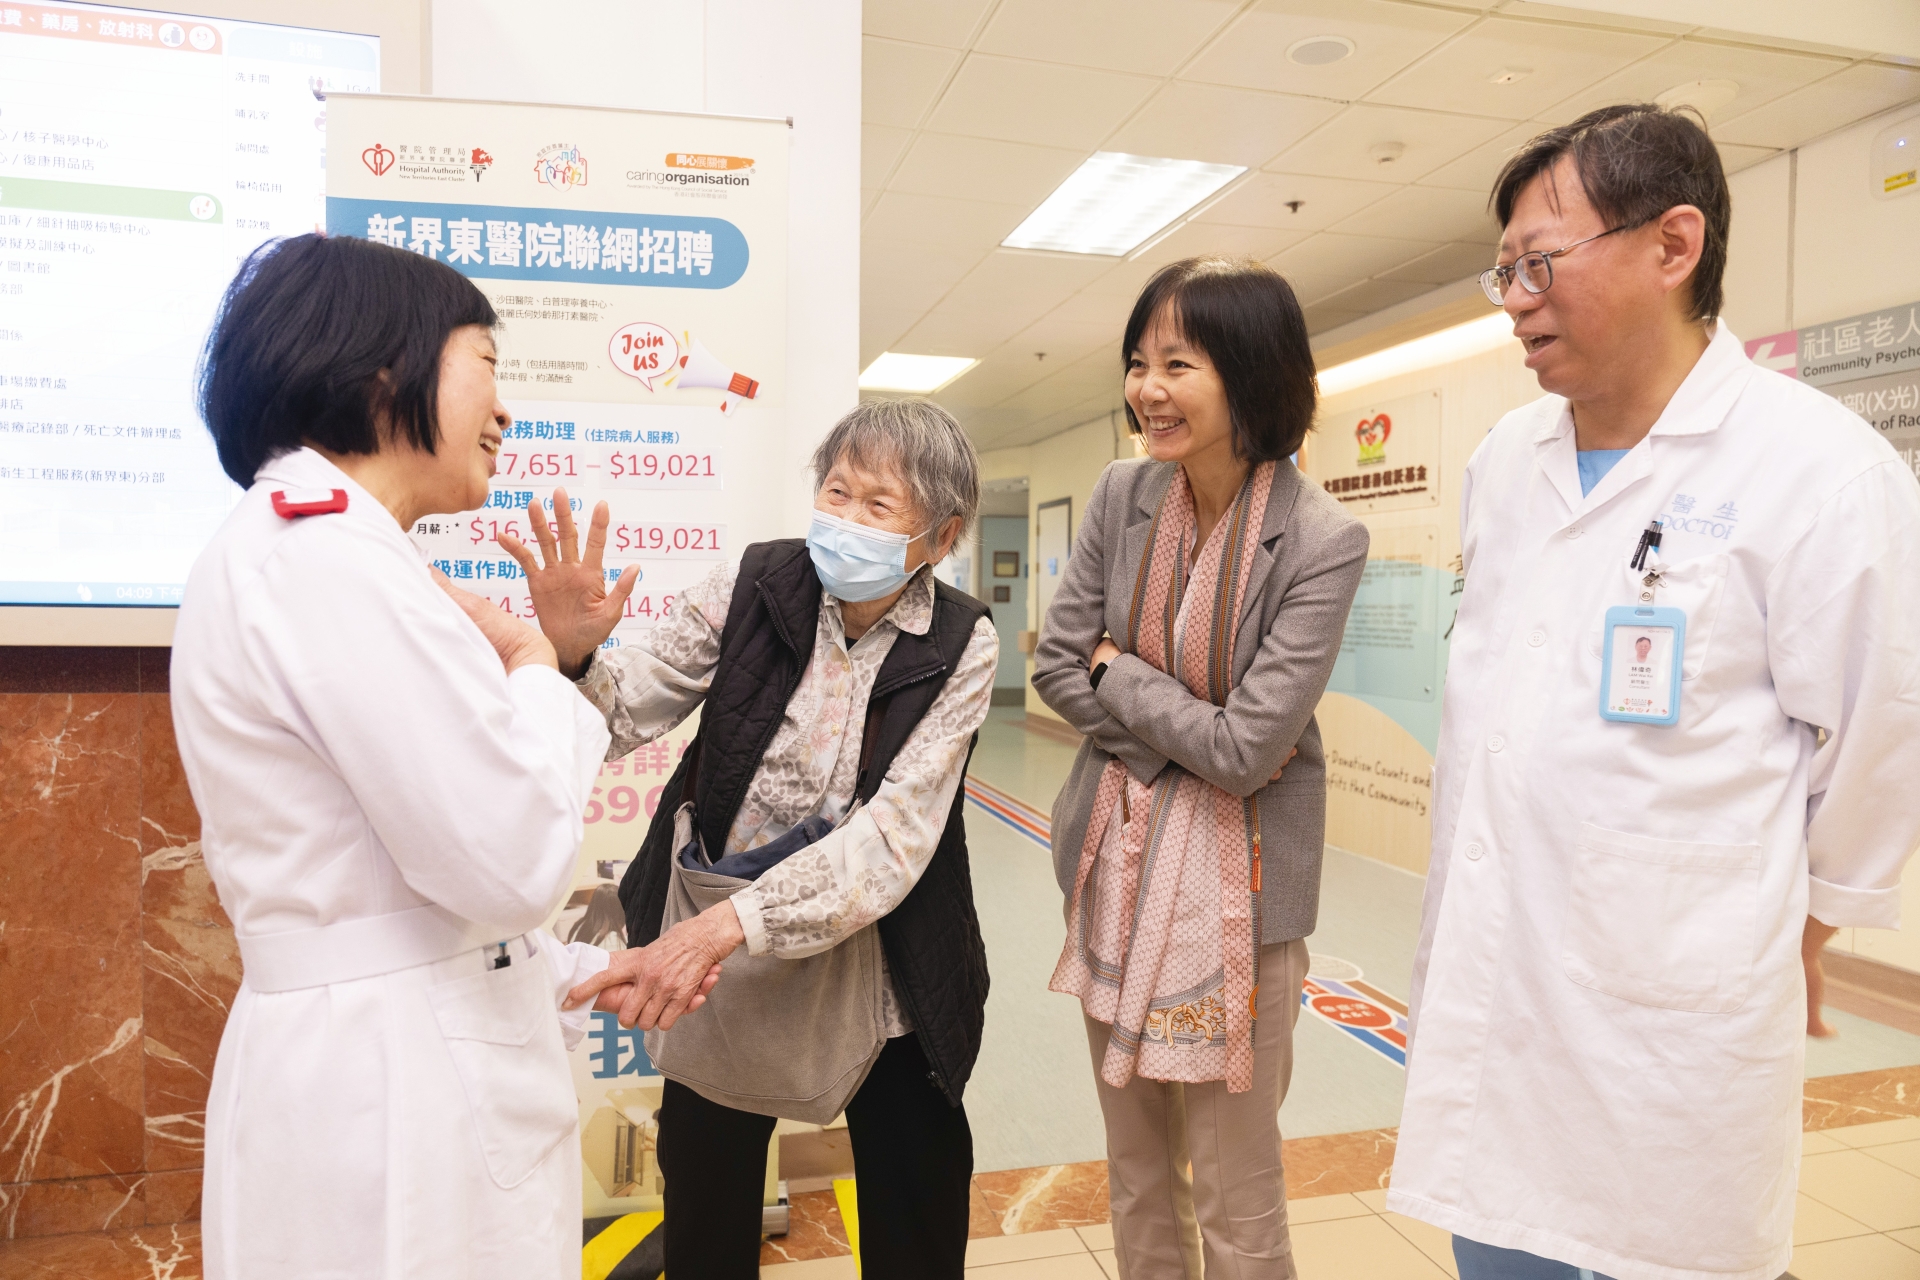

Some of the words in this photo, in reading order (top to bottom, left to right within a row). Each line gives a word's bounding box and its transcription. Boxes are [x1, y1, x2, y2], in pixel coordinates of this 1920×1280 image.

[235, 72, 270, 84] 洗手間
[235, 108, 270, 120] 哺乳室
[23, 130, 109, 149] 核子醫學中心
[399, 144, 466, 157] 醫院管理局
[23, 153, 95, 171] 復康用品店
[676, 154, 728, 169] 同心展關懷
[399, 165, 430, 175] Hospital
[431, 167, 466, 177] Authority
[235, 180, 282, 193] 輪椅借用
[37, 216, 151, 236] 細針抽吸檢驗中心
[236, 218, 270, 230] 提款機
[366, 212, 714, 277] 新界東醫院聯網招聘
[8, 260, 50, 274] 圖書館
[621, 331, 664, 355] Join
[1803, 307, 1920, 363] 社區老人
[1802, 355, 1872, 378] Community
[1880, 414, 1895, 431] of
[84, 424, 182, 440] 死亡文件辦理處
[609, 450, 716, 480] $19,021
[615, 527, 721, 554] $19,021
[116, 586, 153, 599] 04:09
[157, 586, 184, 600] 下午
[1332, 749, 1372, 772] Donation
[1375, 760, 1409, 783] Counts
[1413, 772, 1431, 789] and
[1368, 783, 1427, 817] Community
